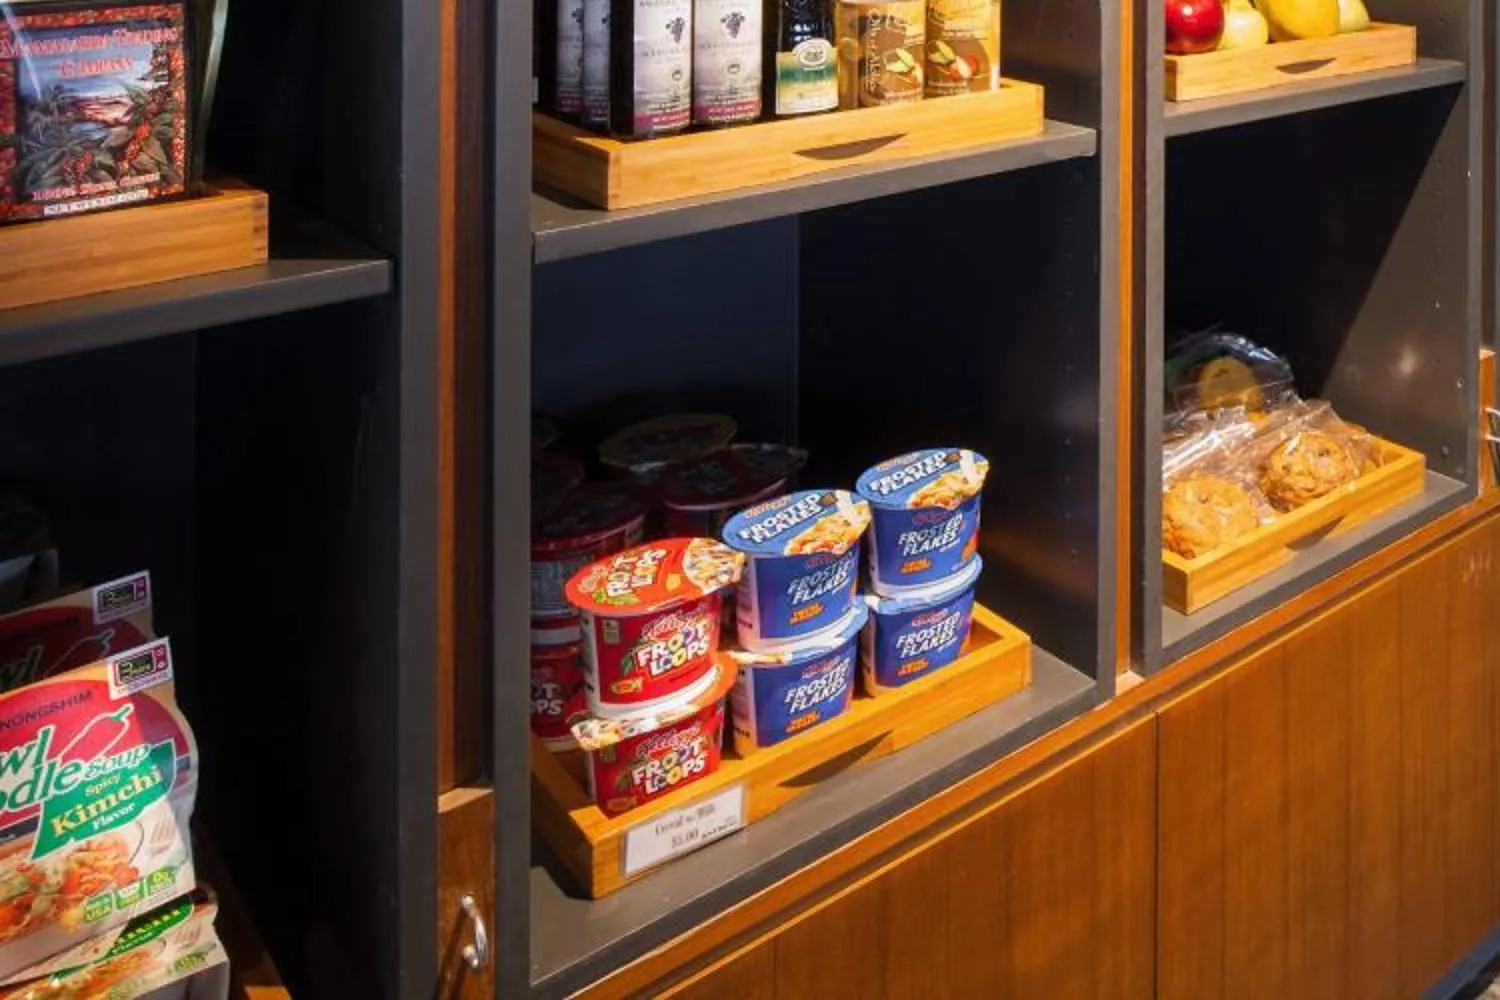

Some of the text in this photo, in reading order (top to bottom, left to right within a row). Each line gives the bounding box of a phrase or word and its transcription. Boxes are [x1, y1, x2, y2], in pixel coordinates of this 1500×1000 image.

[898, 512, 963, 545] FROSTED
[903, 530, 957, 557] FLAKES
[792, 570, 849, 605] FLAKES
[636, 616, 708, 667] FROOT
[896, 611, 962, 648] FROSTED
[901, 629, 957, 659] FLAKES
[650, 635, 710, 676] LOOPS
[785, 656, 851, 704] FROSTED
[790, 675, 847, 713] FLAKES
[86, 743, 150, 780] Soup
[632, 737, 704, 785] FROOT
[645, 753, 708, 794] LOOPS
[51, 764, 162, 838] Kimchi
[85, 772, 121, 797] Spicy
[92, 803, 135, 830] Flavor
